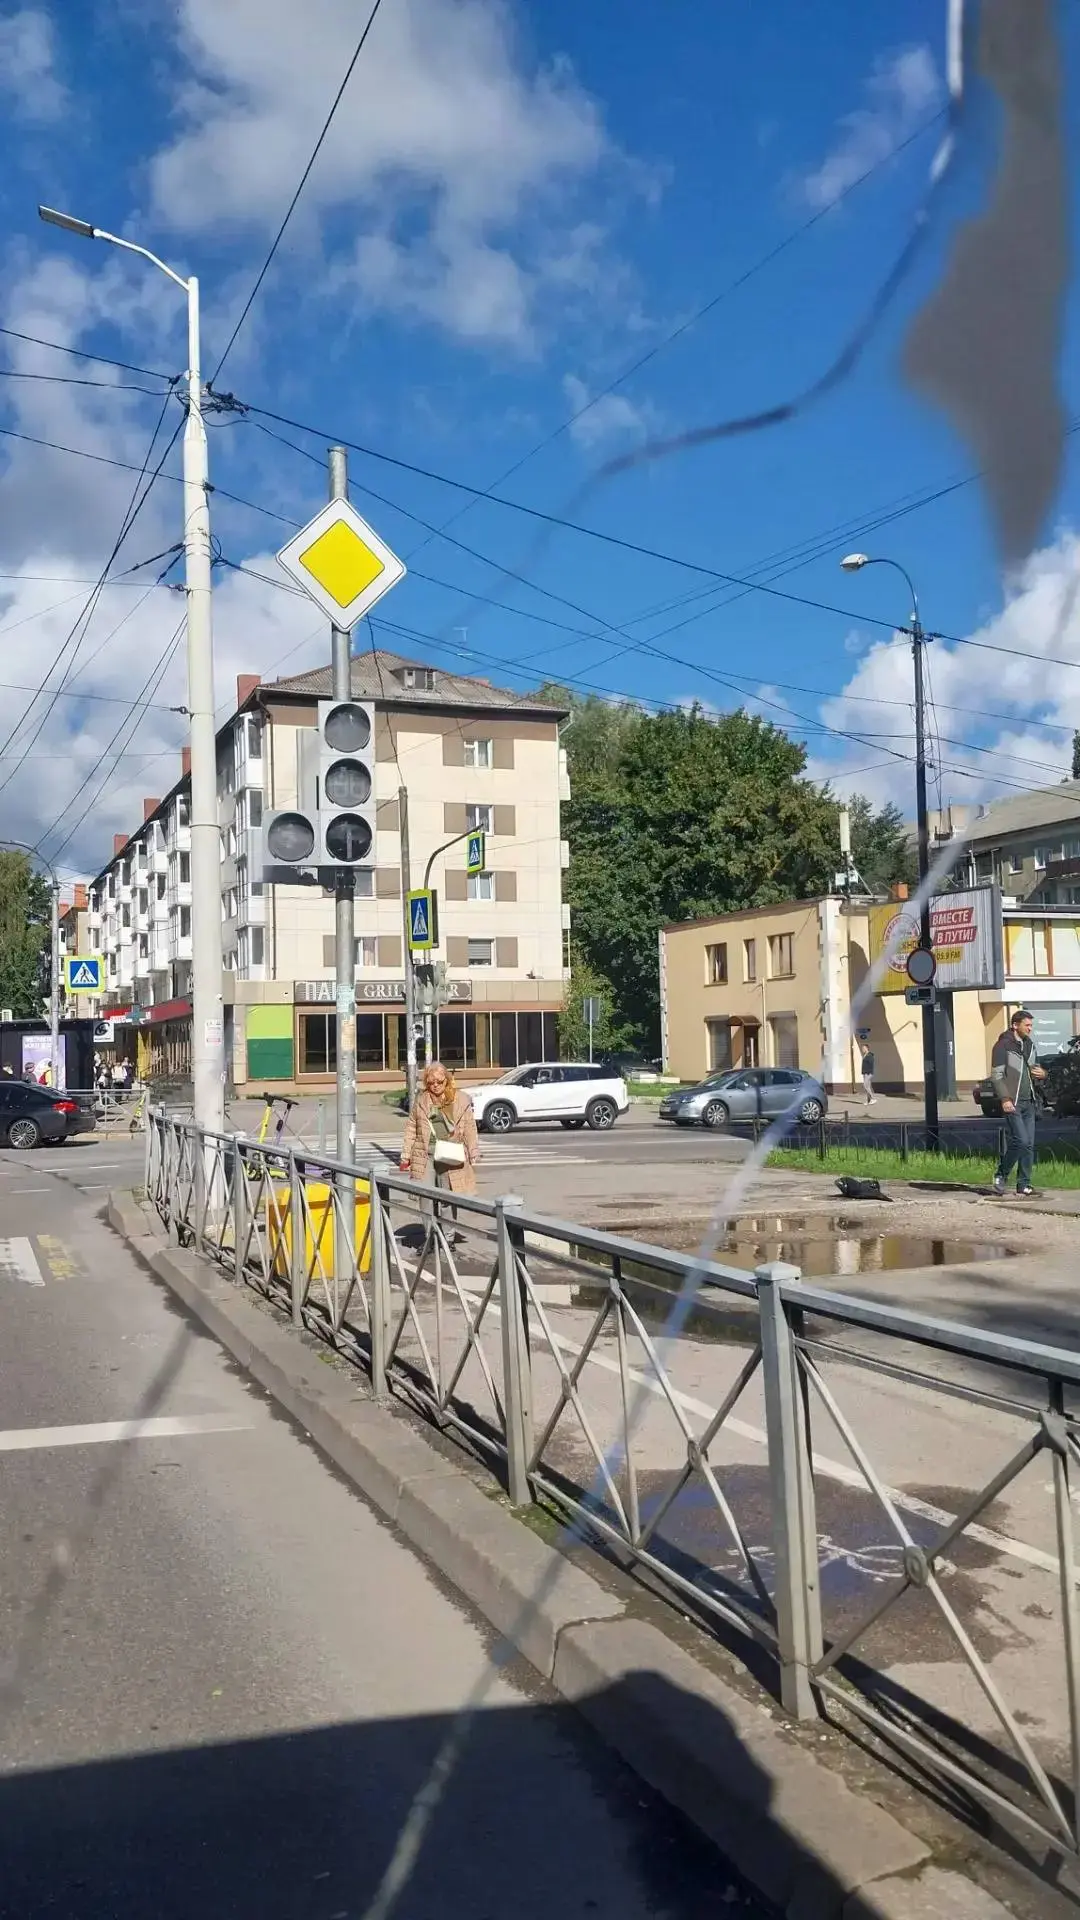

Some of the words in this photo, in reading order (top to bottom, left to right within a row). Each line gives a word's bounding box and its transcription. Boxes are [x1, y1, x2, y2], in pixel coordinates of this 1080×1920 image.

[932, 909, 970, 926] ВМЕСТЕ
[937, 932, 943, 944] В
[944, 928, 974, 943] ПУТИ!
[936, 951, 950, 961] 05.9
[951, 950, 961, 960] FM
